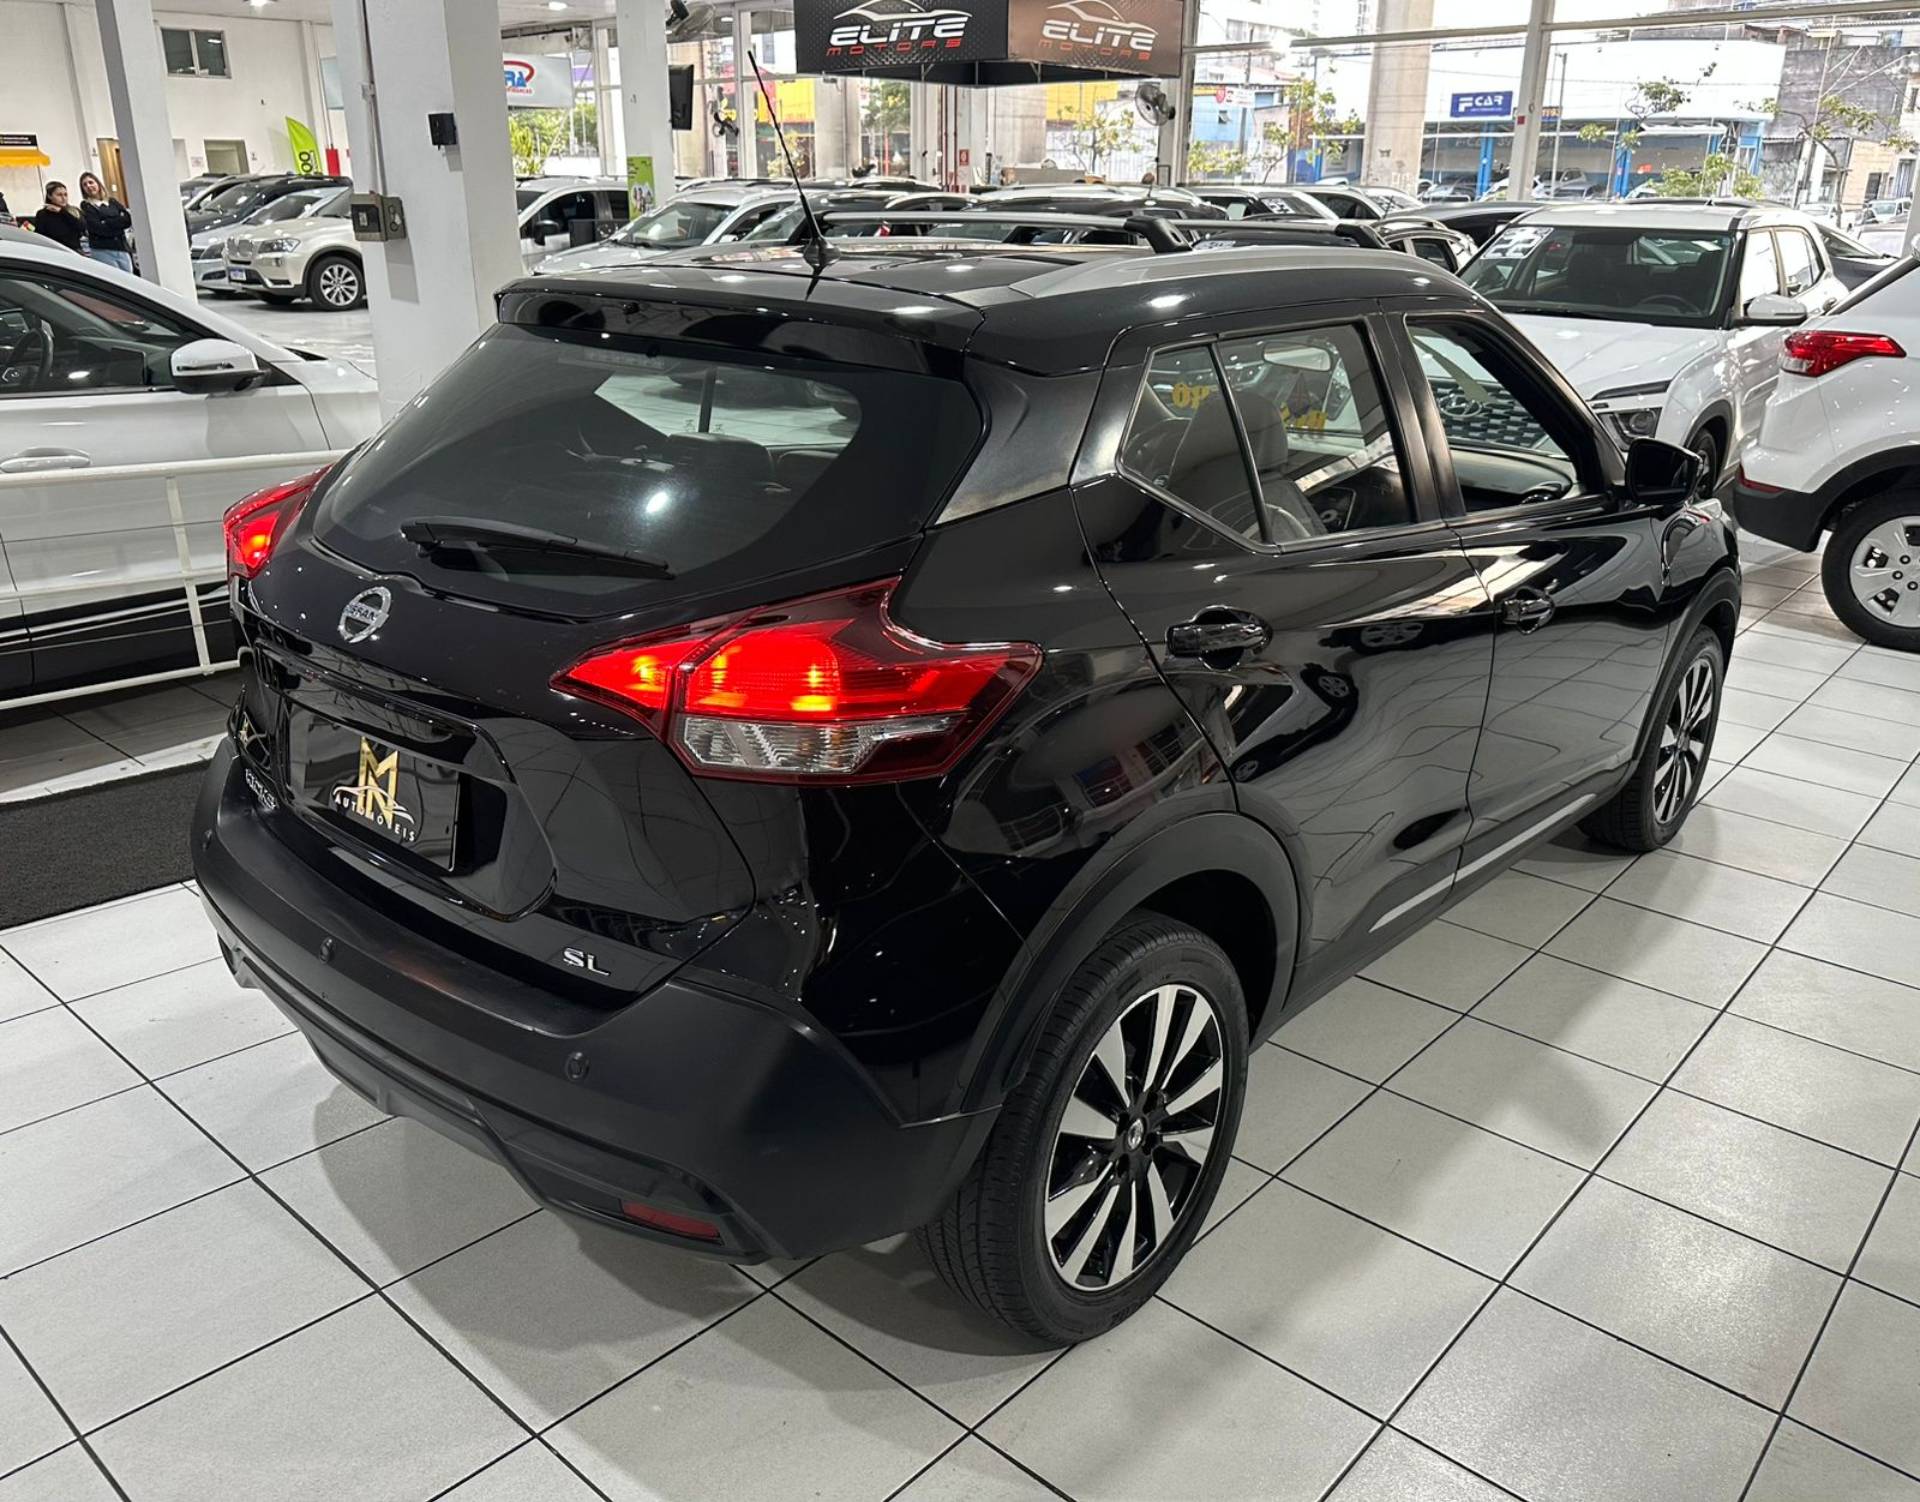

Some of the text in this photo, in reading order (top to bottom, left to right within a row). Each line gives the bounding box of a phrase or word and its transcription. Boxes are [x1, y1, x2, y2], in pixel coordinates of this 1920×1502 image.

[829, 17, 969, 46] ELITE
[1042, 20, 1156, 51] ELITE
[826, 38, 962, 57] MOTORS
[1038, 39, 1151, 61] MOTORS
[563, 947, 610, 976] SL
